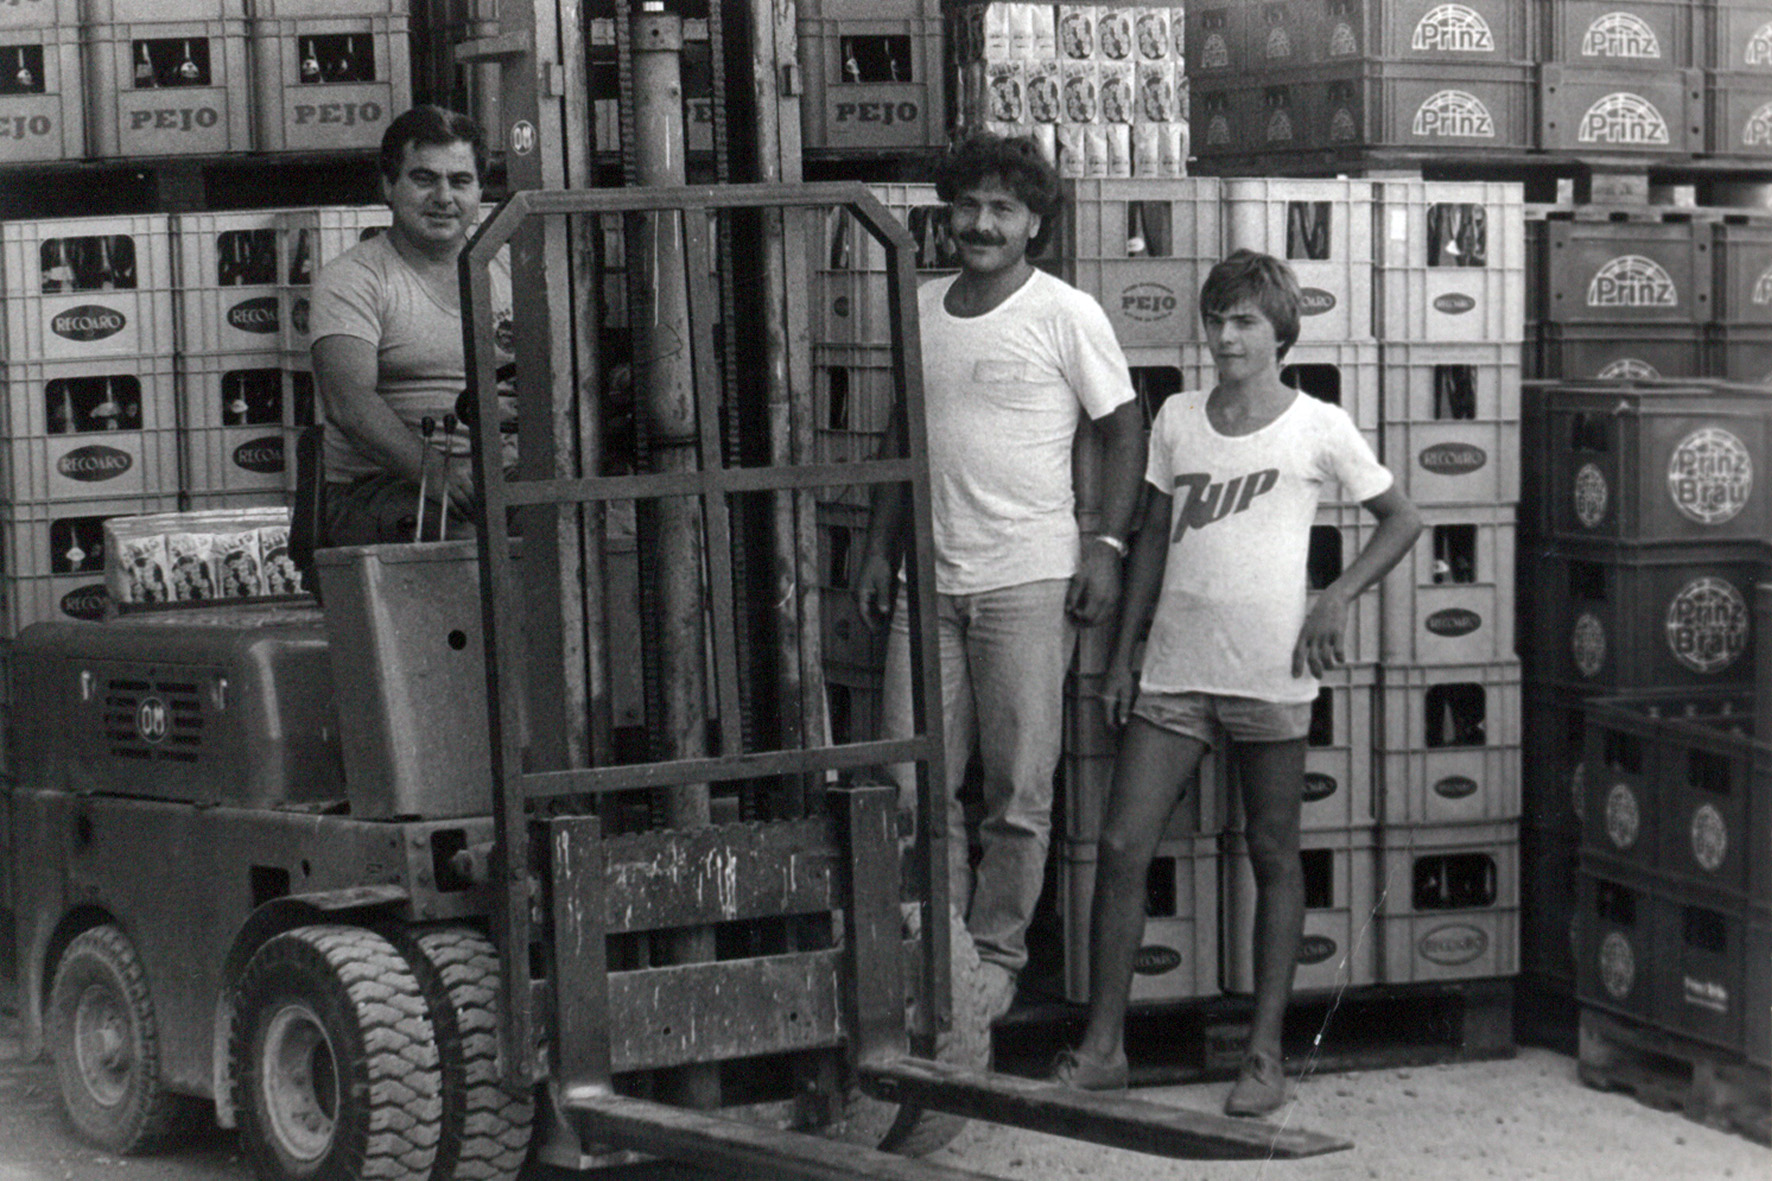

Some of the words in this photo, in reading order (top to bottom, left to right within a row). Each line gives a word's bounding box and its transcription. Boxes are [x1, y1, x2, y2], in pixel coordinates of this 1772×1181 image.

[1421, 24, 1489, 48] Prinz
[1590, 31, 1656, 56] Prinz
[130, 107, 218, 131] PEJO
[294, 102, 382, 126] PEJO
[836, 102, 918, 125] PEJO
[1420, 108, 1489, 134] Prinz
[0, 115, 51, 140] JO
[1588, 114, 1664, 140] Prinz
[1597, 277, 1672, 301] Prinz
[1121, 295, 1177, 312] PEJO
[56, 315, 121, 331] RECOARO
[60, 455, 128, 473] RECOARO
